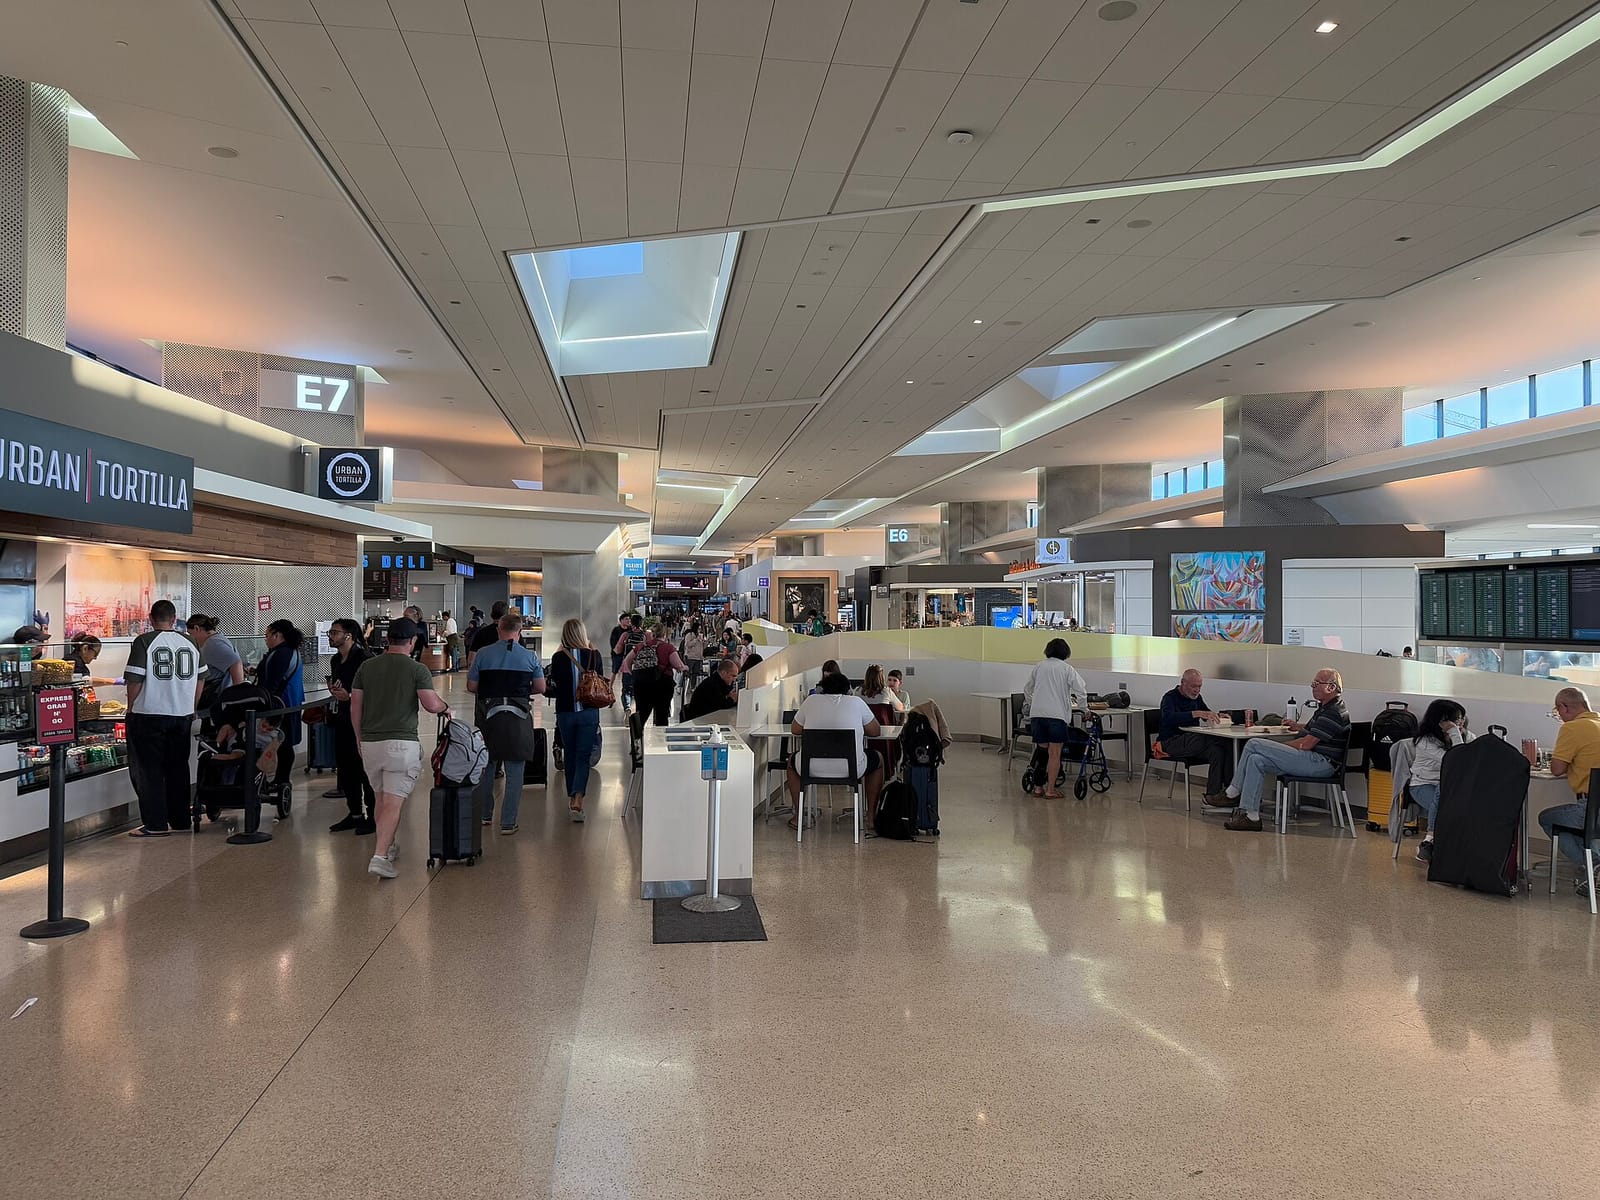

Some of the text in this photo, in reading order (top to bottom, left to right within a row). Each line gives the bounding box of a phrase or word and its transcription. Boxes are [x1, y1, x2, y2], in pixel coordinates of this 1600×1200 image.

[296, 374, 349, 412] E7
[335, 465, 363, 475] URBAN
[96, 459, 189, 511] TORTILLA
[335, 475, 363, 484] TORTILLA
[889, 528, 908, 542] E6
[381, 555, 425, 569] DELI
[152, 646, 194, 680] 80
[40, 694, 73, 703] EXPRESS
[46, 702, 67, 710] GRAB
